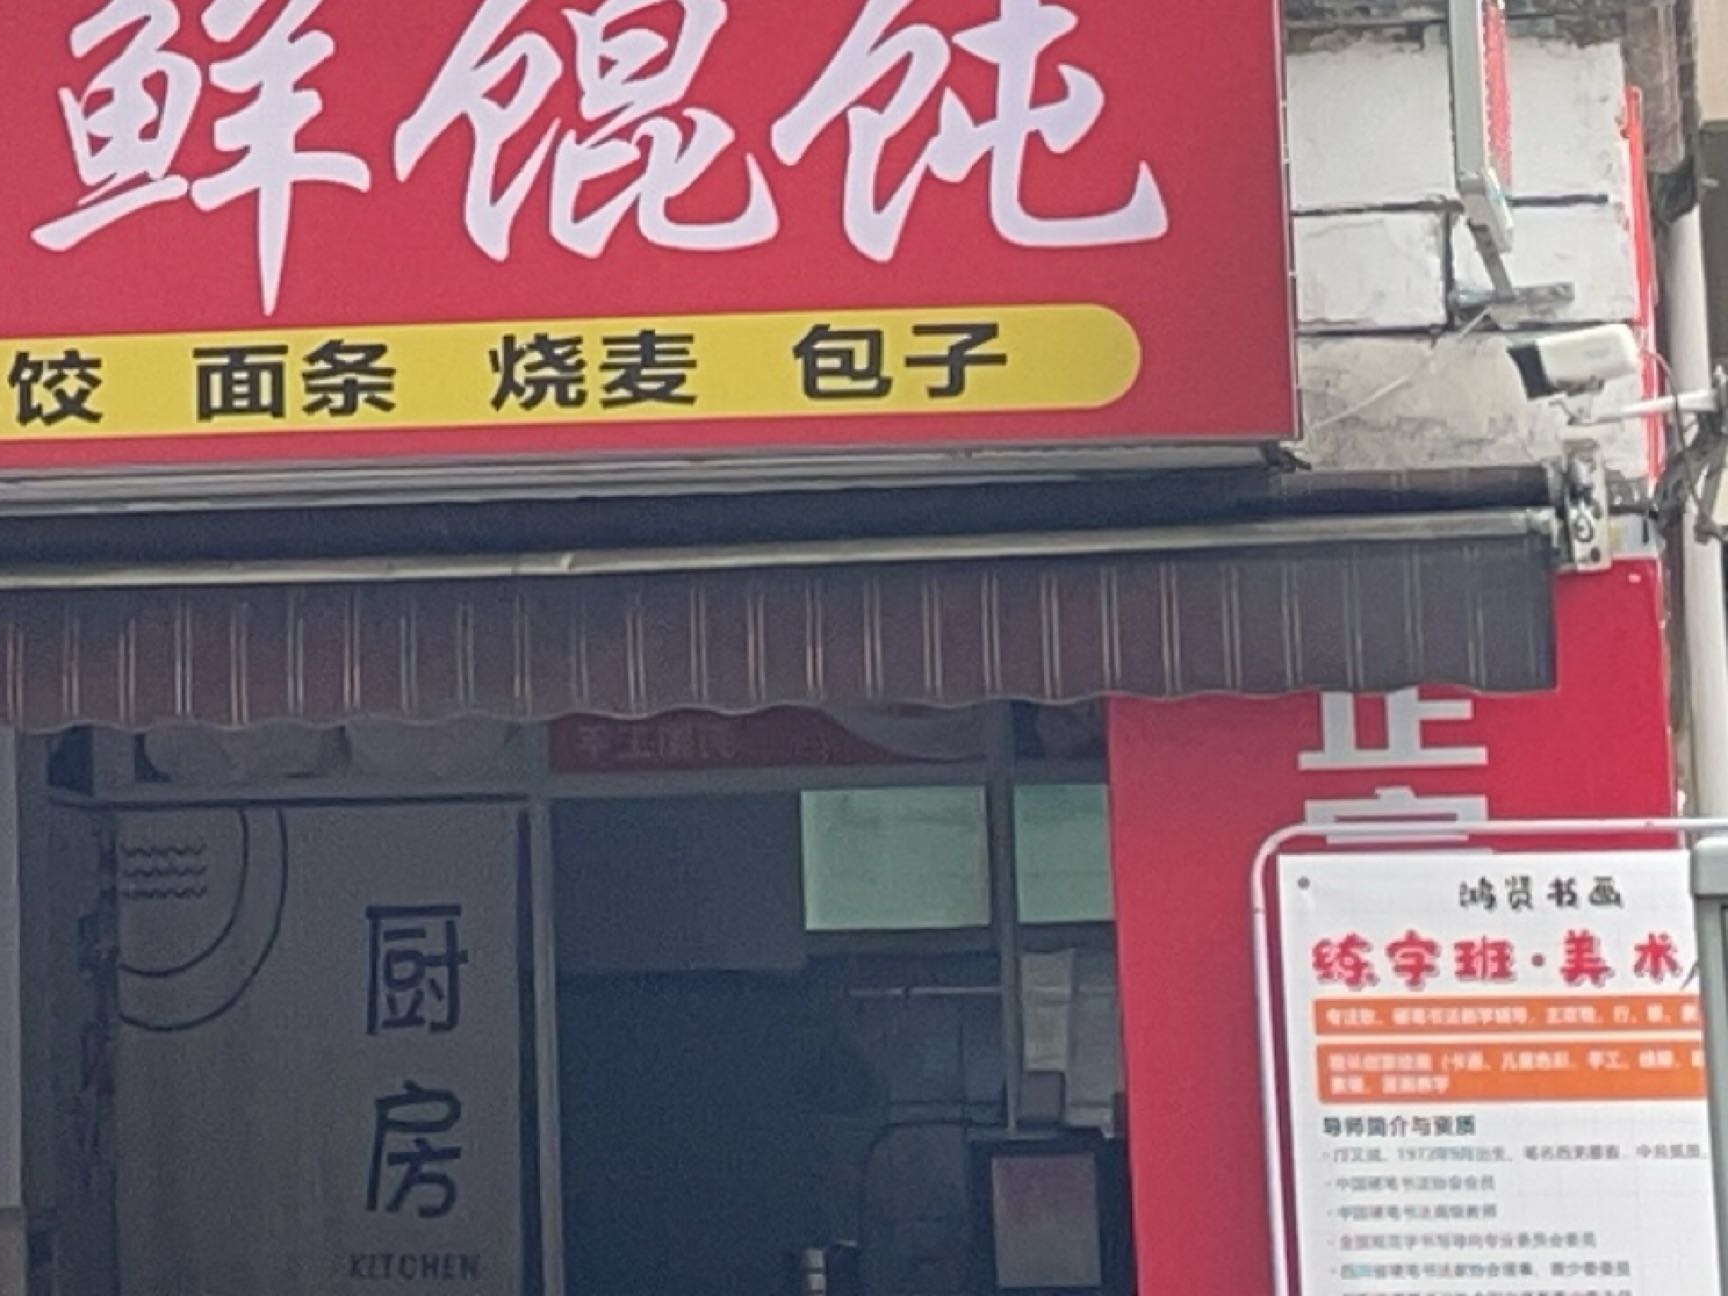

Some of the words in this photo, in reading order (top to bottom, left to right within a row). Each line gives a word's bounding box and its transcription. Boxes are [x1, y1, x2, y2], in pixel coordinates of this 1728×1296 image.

[192, 339, 398, 422] 面条
[489, 327, 699, 411] 烧麦
[792, 321, 1009, 399] 包子
[365, 904, 469, 1219] 厨房
[350, 1252, 480, 1282] KITCHEN
